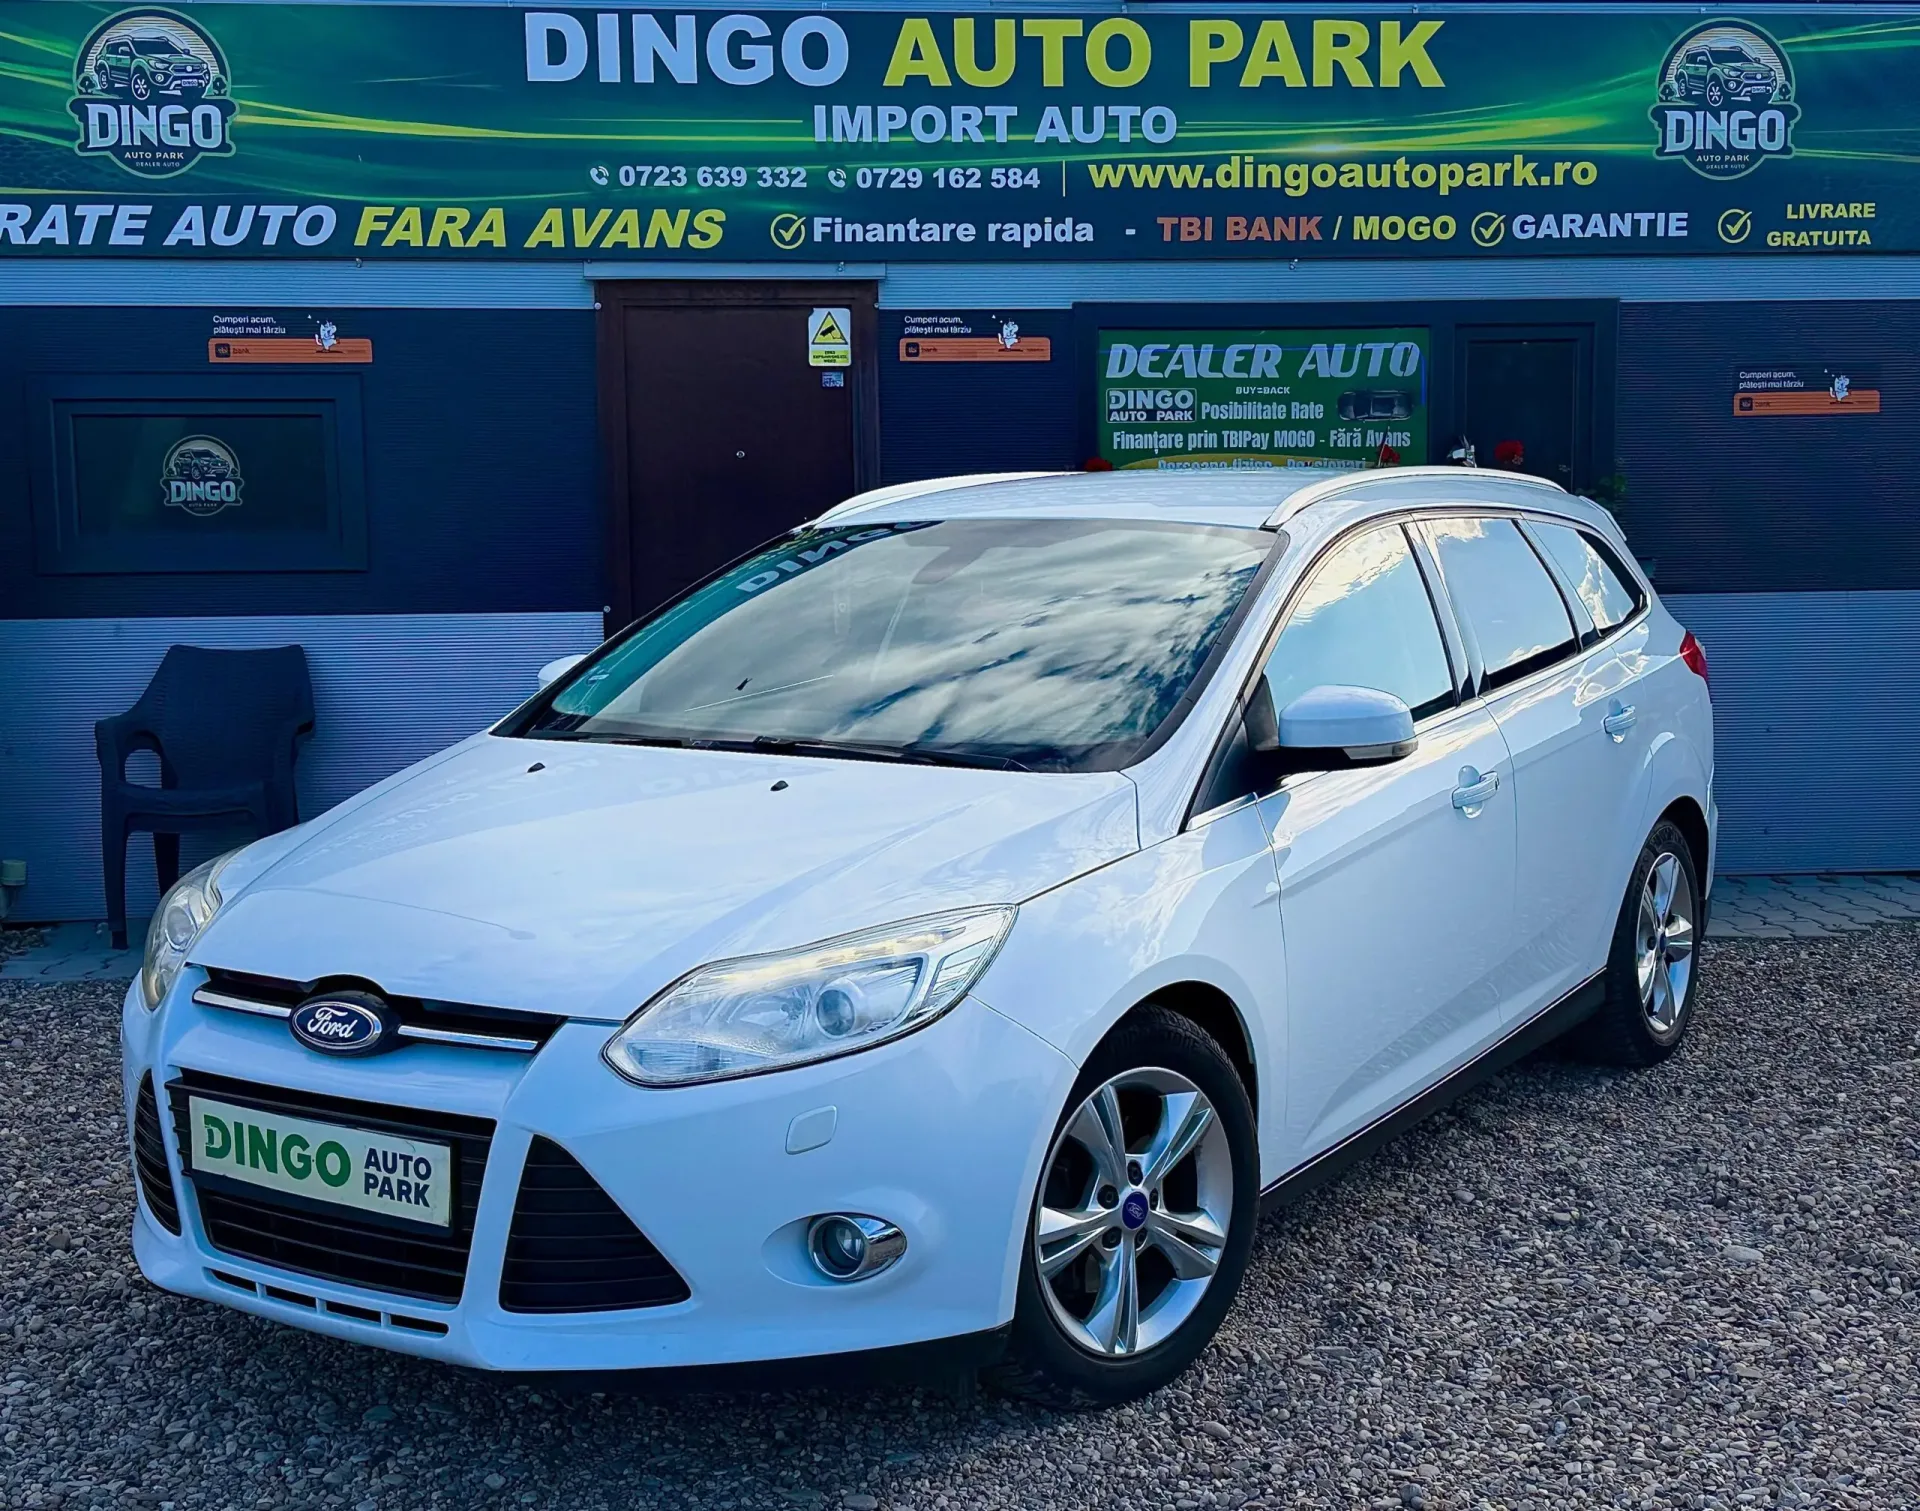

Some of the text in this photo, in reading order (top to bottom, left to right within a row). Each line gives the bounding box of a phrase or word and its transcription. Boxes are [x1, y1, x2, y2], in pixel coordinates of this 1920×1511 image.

[524, 12, 1446, 89] DINGO AUTO PARK
[85, 104, 222, 148] DINGO
[814, 104, 1178, 144] IMPORT AUTO
[1664, 109, 1786, 153] DINGO
[124, 151, 184, 160] AUTO PARK
[135, 160, 181, 168] DEALER AUTO
[1696, 154, 1750, 163] AUTO PARK
[618, 165, 808, 189] 0723 639 332
[856, 167, 1040, 190] 0729 162 584
[1088, 156, 1597, 196] www.dingoautopark.ro
[1786, 203, 1876, 220] LIVRARE
[0, 204, 726, 249] RATE AUTO FARA AVANS
[813, 216, 979, 244] Finantare
[987, 217, 1094, 249] rapida
[1156, 216, 1213, 243] TBI
[1225, 216, 1323, 242] BANK
[1353, 215, 1457, 242] MOGO
[1512, 212, 1688, 241] GARANTIE
[1766, 230, 1871, 248] GRATUITA
[1106, 341, 1420, 378] DEALER AUTO
[1109, 390, 1194, 409] DINGO
[1201, 401, 1323, 420] Posibilitate Rate
[1110, 410, 1193, 421] AUTO PARK
[1187, 431, 1217, 450] prin
[1222, 430, 1269, 450] TBIPay
[1274, 430, 1315, 447] MOGO
[1330, 429, 1362, 447] Fără
[1366, 429, 1411, 447] Avans
[170, 481, 236, 502] DINGO
[307, 1006, 358, 1038] Ford
[203, 1114, 351, 1188] DINGO
[364, 1148, 432, 1181] AUTO
[364, 1172, 431, 1207] PARK
